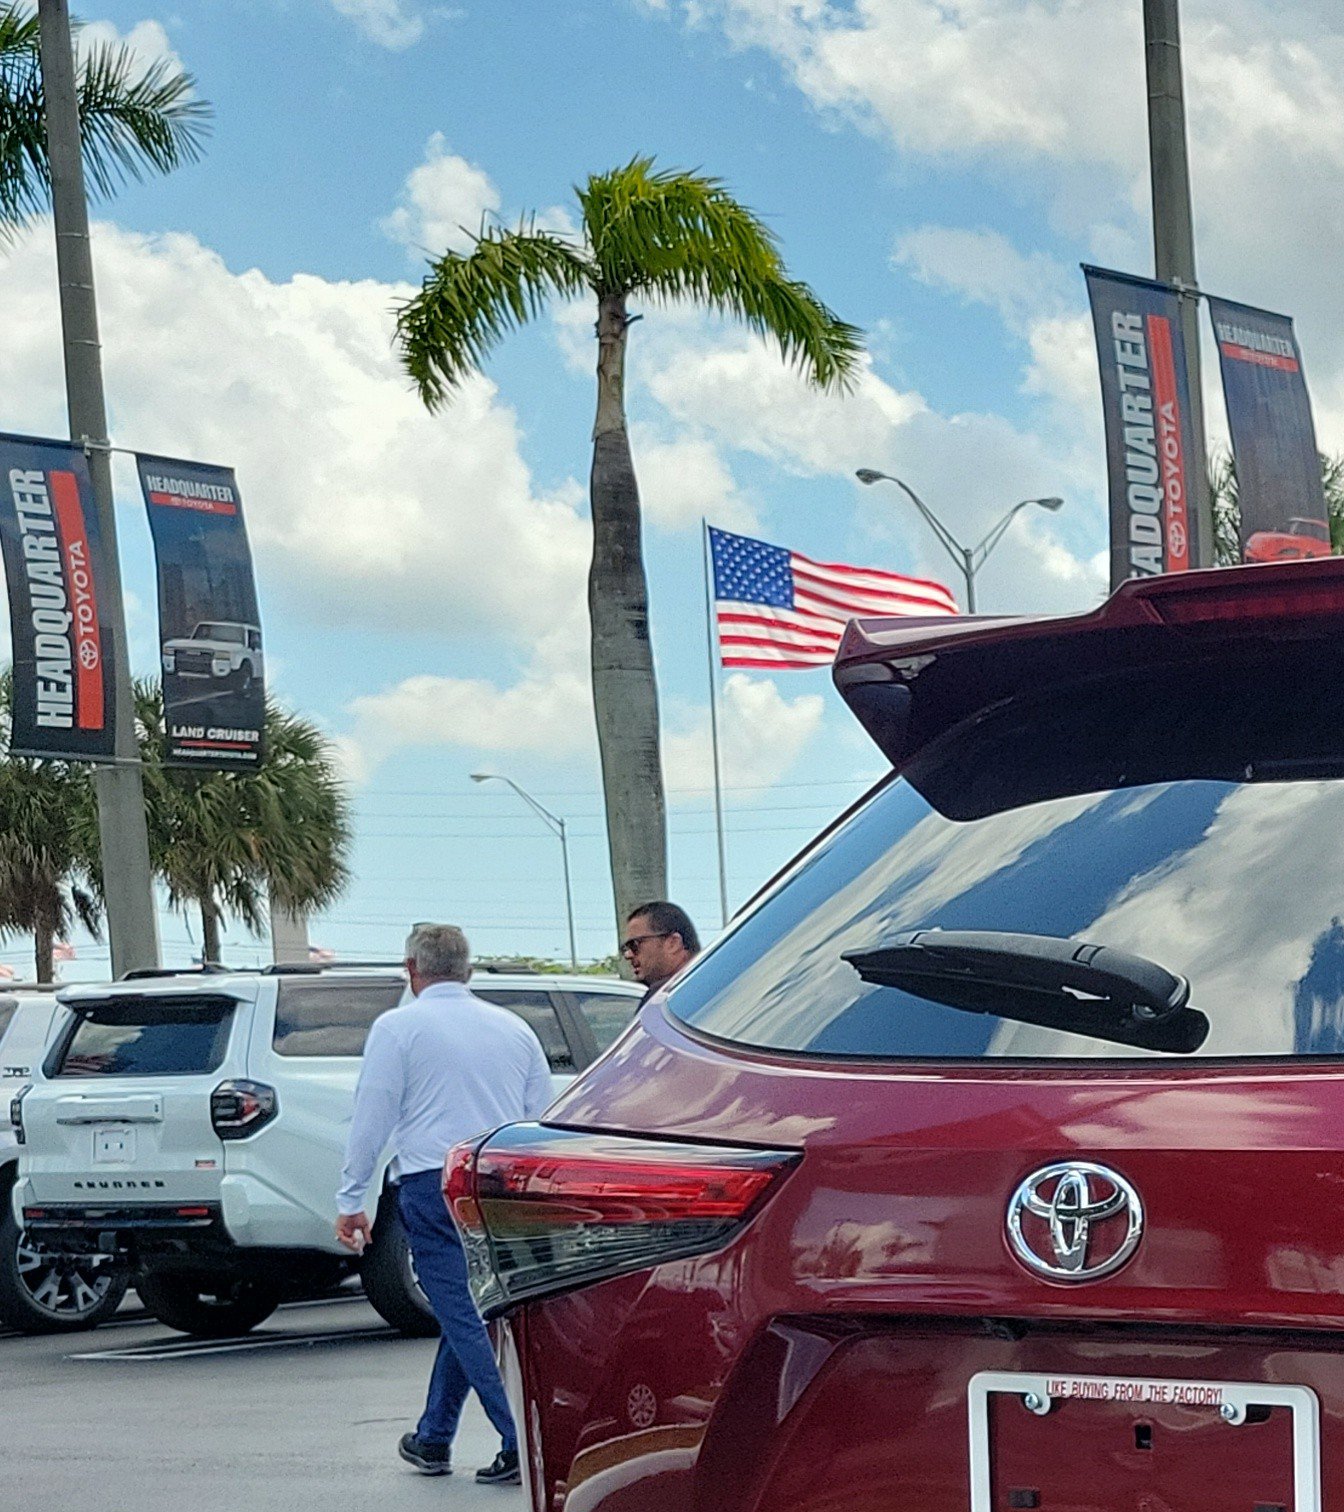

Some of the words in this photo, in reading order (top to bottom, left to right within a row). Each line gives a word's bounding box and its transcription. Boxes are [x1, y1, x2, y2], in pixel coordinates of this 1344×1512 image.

[146, 474, 234, 503] HEADQUARTER
[1111, 310, 1164, 577] ADQUARTER
[1160, 402, 1182, 517] TOYOTA
[9, 468, 74, 728] HEADQUARTER
[68, 539, 95, 636] TOYOTA
[171, 724, 204, 739] LAND
[206, 727, 260, 742] CRUISER
[1045, 1379, 1067, 1397] LIKE
[1072, 1380, 1110, 1400] BUYING
[1114, 1382, 1143, 1401] FROM
[1148, 1384, 1168, 1401] THE
[1173, 1385, 1223, 1405] FACTORY!
